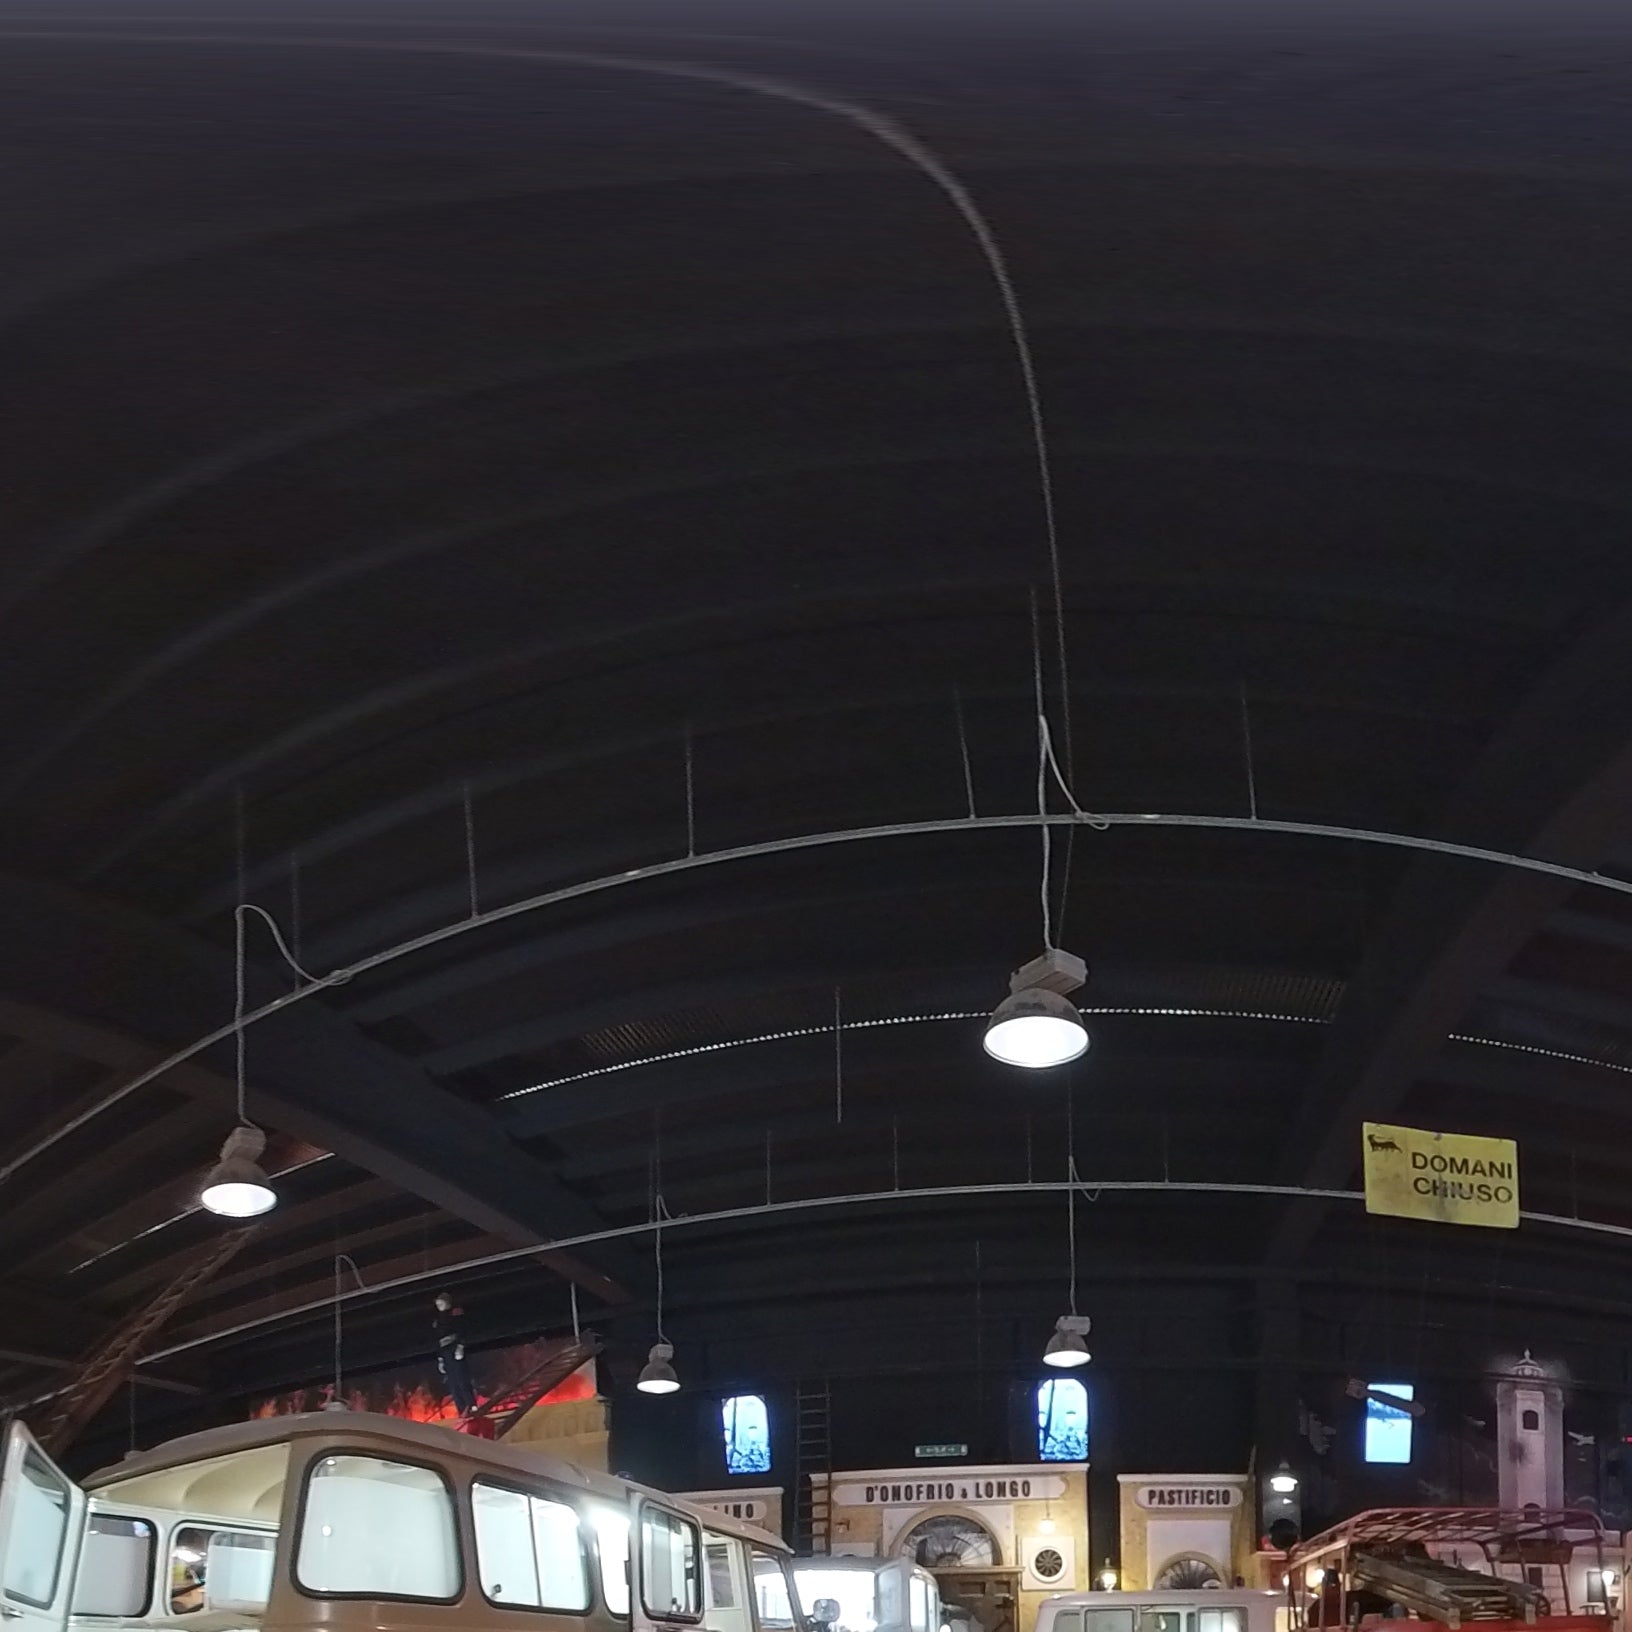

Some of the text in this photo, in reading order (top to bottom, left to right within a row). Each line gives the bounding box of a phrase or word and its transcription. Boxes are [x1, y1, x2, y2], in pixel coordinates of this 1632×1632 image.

[1411, 1151, 1513, 1180] DOMANI
[1413, 1176, 1513, 1204] CHIUSO
[866, 1482, 955, 1502] D'ONOFRIO
[975, 1480, 1031, 1499] LONGO
[1148, 1489, 1231, 1506] PASTIFICIO
